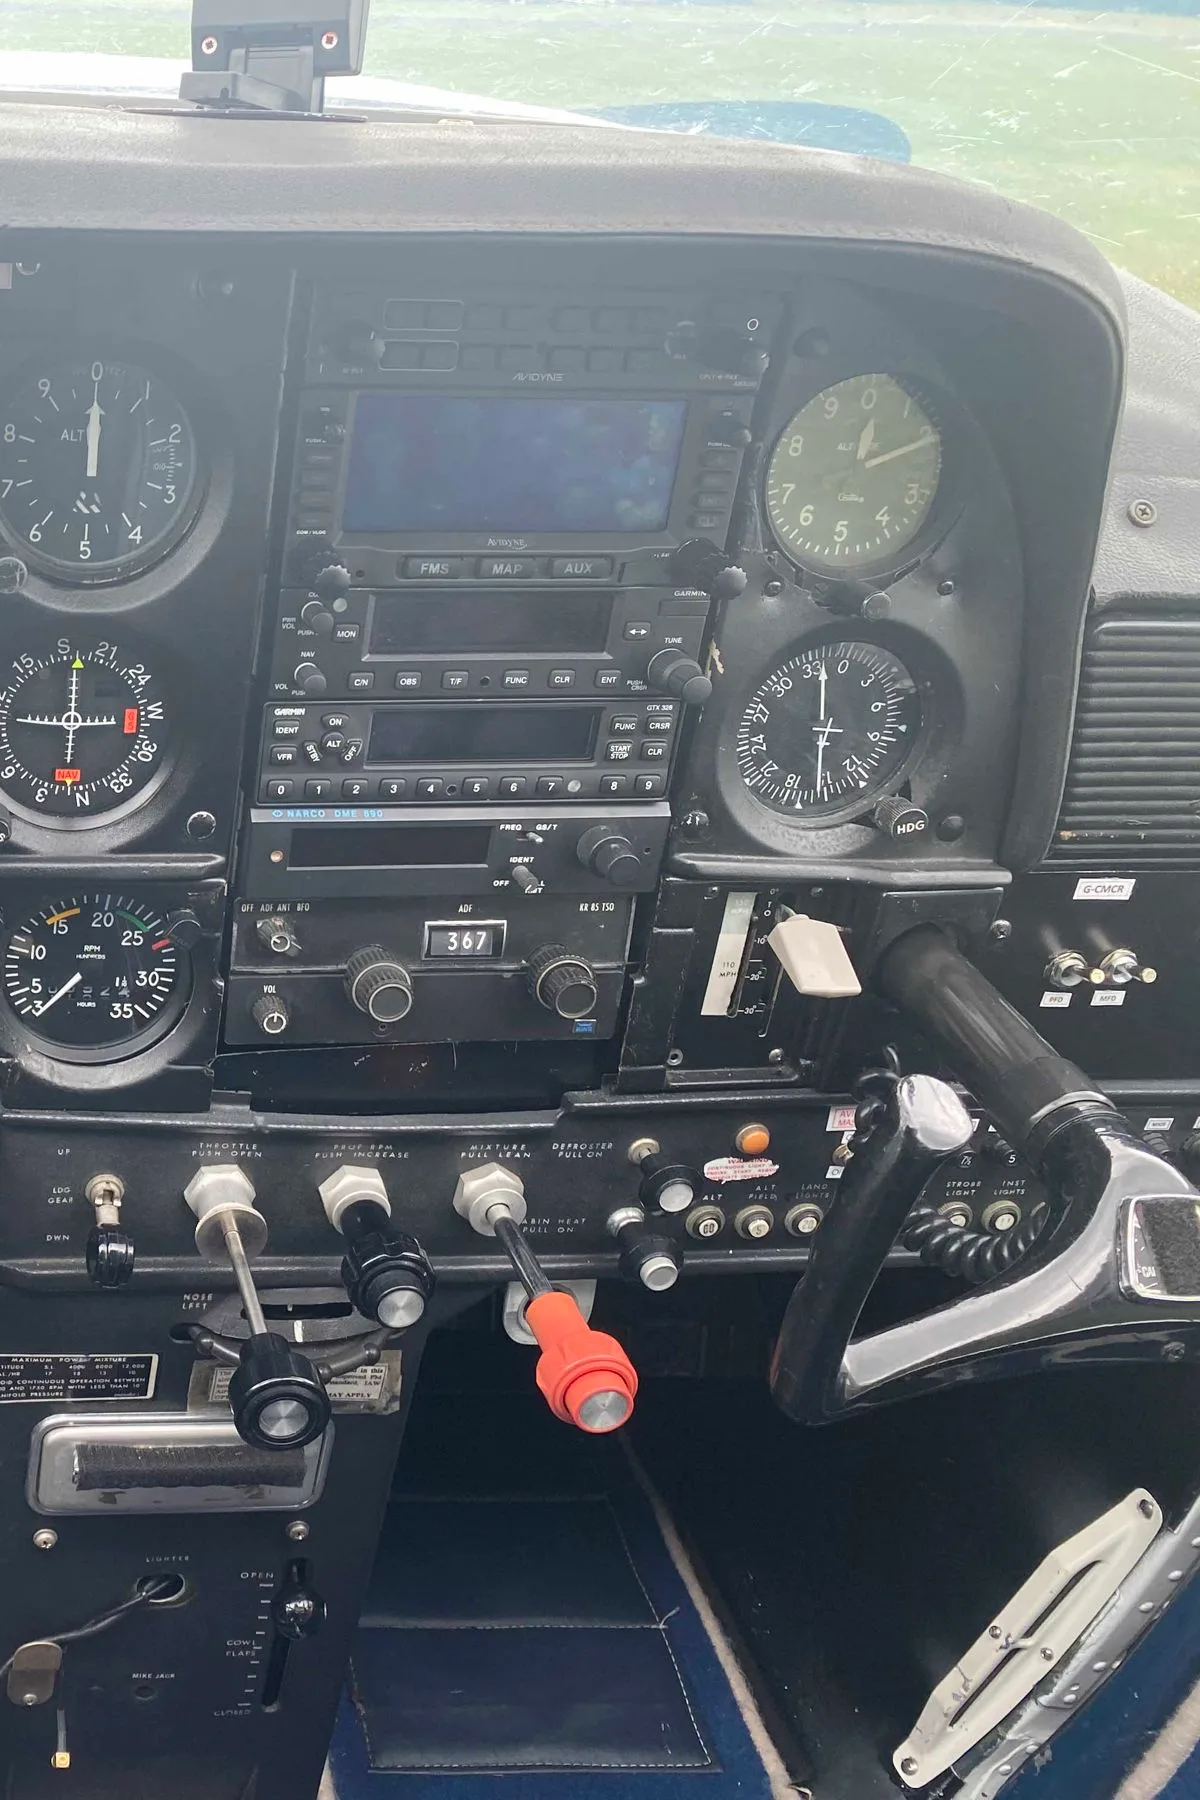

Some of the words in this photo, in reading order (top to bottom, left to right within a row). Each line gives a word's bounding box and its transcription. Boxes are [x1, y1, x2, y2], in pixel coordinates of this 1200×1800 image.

[91, 361, 104, 382] 0
[3, 423, 16, 442] 8
[60, 429, 85, 441] ALT
[168, 424, 181, 443] 2
[782, 483, 796, 505] 7
[28, 523, 42, 542] 6
[128, 525, 143, 544] 4
[833, 520, 849, 542] 5
[79, 541, 91, 560] 5
[419, 562, 450, 575] FMS
[491, 562, 523, 576] MAP
[563, 562, 594, 575] AUX
[336, 628, 357, 640] MON
[663, 637, 683, 645] TUNE
[56, 638, 71, 655] S
[94, 641, 118, 661] 21
[300, 651, 316, 659] NAV
[127, 663, 152, 686] 24
[353, 678, 369, 688] C/N
[399, 676, 418, 687] OBS
[448, 677, 463, 687] T/F
[504, 675, 528, 686] FUNC
[553, 675, 571, 685] CLR
[600, 675, 618, 685] ENT
[147, 701, 164, 720] W
[274, 707, 306, 716] GARMIN
[646, 704, 659, 712] GTX
[752, 703, 771, 724] 27
[328, 718, 343, 727] ON
[614, 722, 637, 732] FUNC
[648, 721, 671, 731] CRSR
[275, 726, 299, 734] IDENT
[326, 740, 341, 748] ALT
[751, 733, 767, 754] 24
[306, 744, 321, 763] STBY
[344, 745, 358, 761] OFF
[609, 745, 632, 754] START
[647, 747, 663, 757] CLR
[276, 753, 293, 761] VFR
[610, 752, 629, 760] STOP
[277, 785, 285, 795] 0
[352, 784, 361, 795] 2
[426, 783, 435, 794] 4
[472, 783, 481, 793] 5
[547, 781, 555, 792] 7
[644, 780, 653, 791] 9
[75, 791, 90, 808] N
[286, 809, 326, 819] NARCO
[334, 809, 358, 818] DME
[535, 823, 558, 832] GS/T
[896, 820, 926, 835] HDG
[509, 856, 534, 864] IDENT
[1083, 885, 1125, 894] G-CMCR
[241, 904, 255, 913] OFF
[260, 904, 274, 913] ADF
[277, 904, 291, 913] ANT
[458, 904, 473, 913] ADF
[91, 912, 115, 928] 20
[52, 920, 69, 935] 15
[121, 930, 144, 946] 25
[447, 931, 488, 951] 367
[30, 944, 47, 960] 10
[135, 970, 160, 987] 30
[263, 984, 277, 994] VOL
[199, 1142, 258, 1150] THROTTLE
[469, 1143, 527, 1152] MIXTURE
[551, 1142, 613, 1150] DEFROSTER
[191, 1150, 222, 1158] PUSH
[353, 1151, 410, 1159] INCREASE
[498, 1151, 532, 1159] LEAN
[558, 1151, 583, 1159] PULL
[52, 1186, 72, 1194] LDG
[945, 1189, 976, 1197] LIGHT
[46, 1234, 70, 1242] DWN
[240, 1571, 275, 1579] OPEN
[132, 1672, 153, 1680] MIKE
